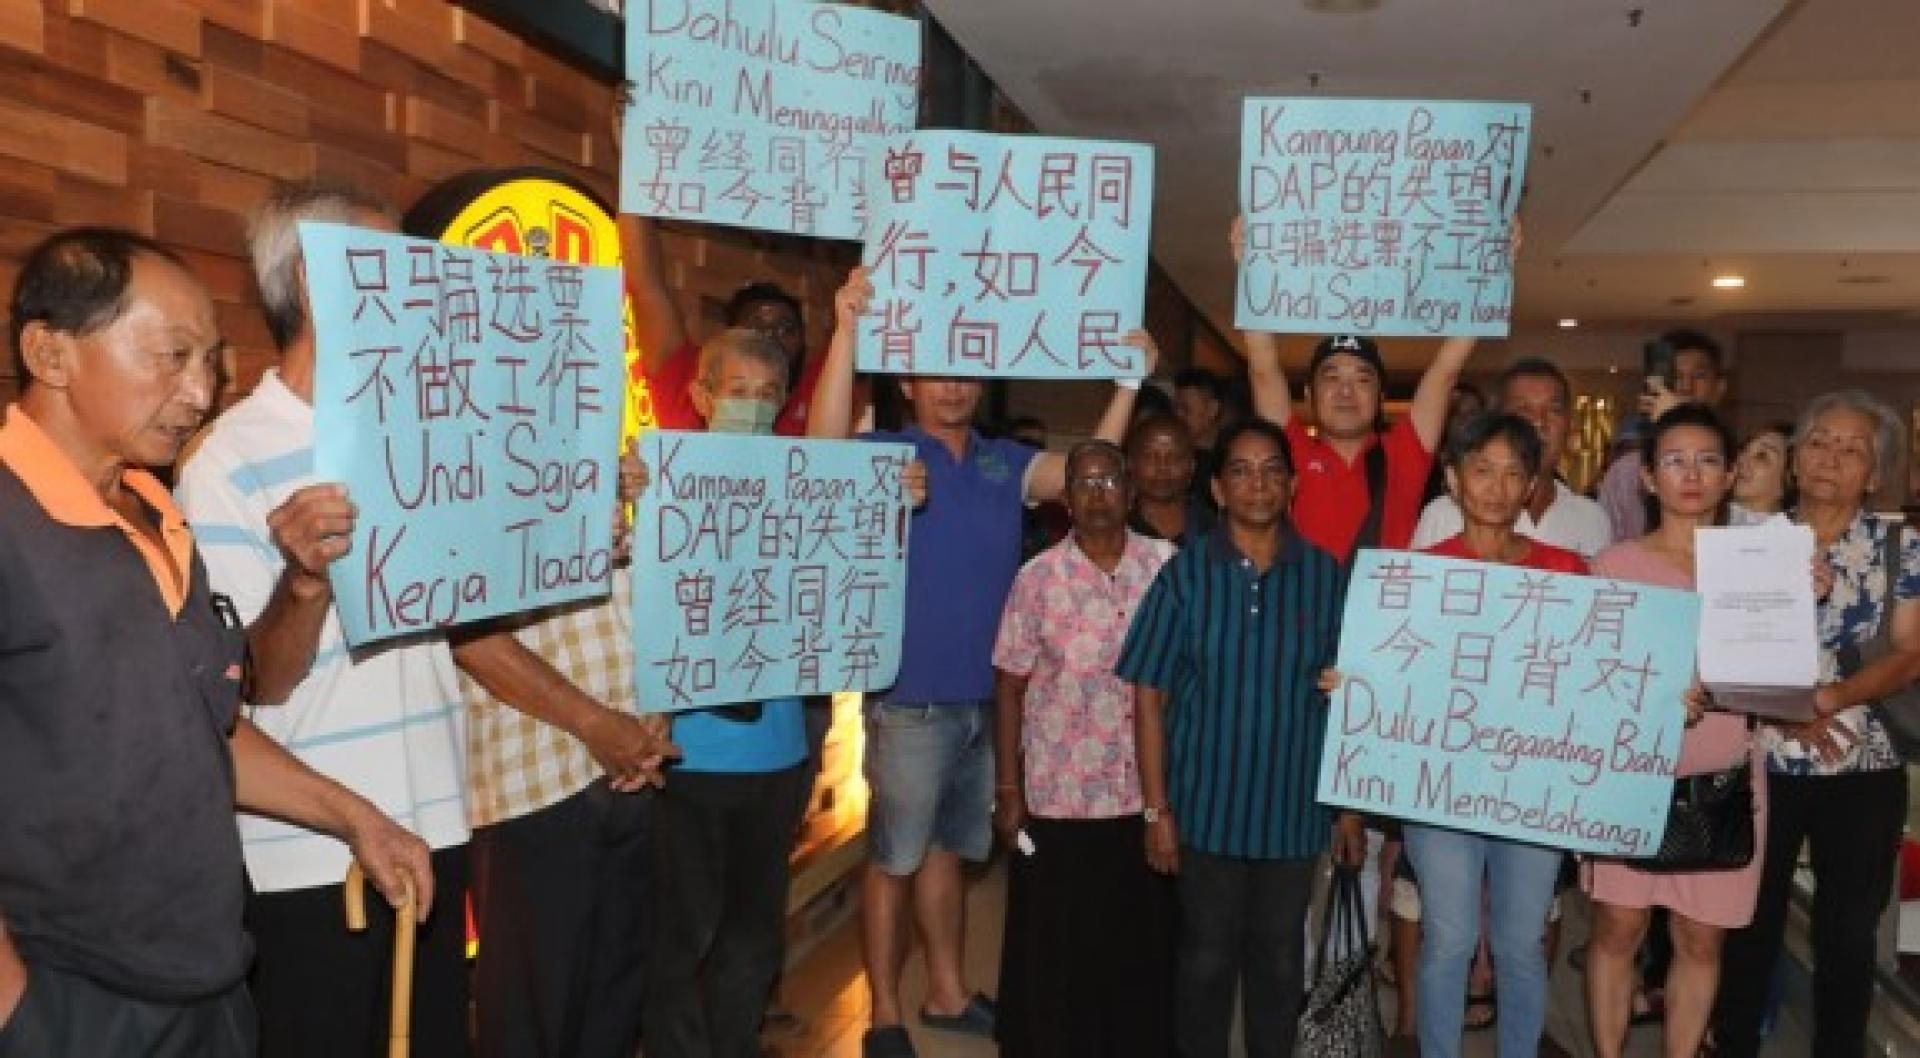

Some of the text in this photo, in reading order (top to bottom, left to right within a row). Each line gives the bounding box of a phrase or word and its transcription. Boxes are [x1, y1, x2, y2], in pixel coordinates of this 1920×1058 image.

[647, 0, 800, 65] Dahulu
[647, 51, 713, 107] Kini
[646, 115, 867, 191] 曾经同行
[1260, 106, 1525, 166] Kampung Papan 对
[883, 138, 1132, 230] 曾与人民同
[345, 243, 597, 353] 只骗选票
[866, 299, 1133, 370] 背向人民
[1245, 269, 1318, 317] Undi
[1327, 271, 1396, 330] Saja
[345, 333, 603, 430] 不做工作
[385, 421, 601, 513] Undi Saja
[656, 438, 768, 511] Kampung
[784, 445, 857, 508] Papan
[365, 516, 612, 631] Kerja Tiada
[674, 565, 889, 636] 曾经同行
[1367, 558, 1639, 651] 昔日并肩
[651, 624, 885, 704] 如今背弃
[1371, 615, 1662, 713] 今日背对
[1342, 676, 1436, 747] Dulu
[1440, 687, 1605, 786] Berganding
[1330, 741, 1654, 854] Kini Membelakangi
